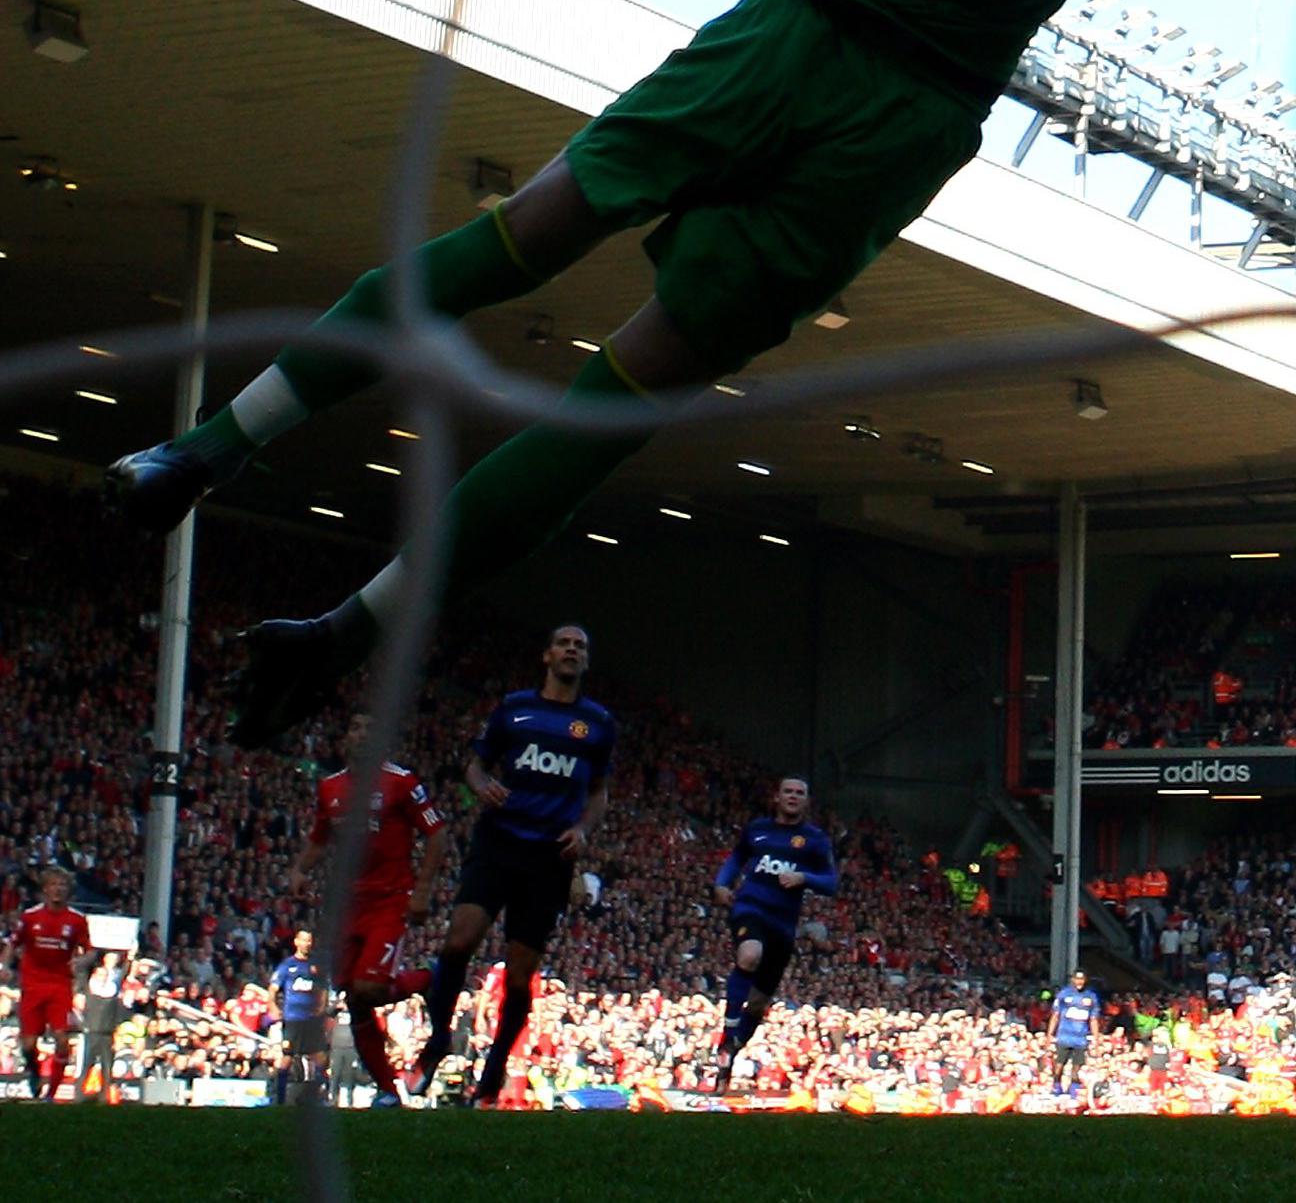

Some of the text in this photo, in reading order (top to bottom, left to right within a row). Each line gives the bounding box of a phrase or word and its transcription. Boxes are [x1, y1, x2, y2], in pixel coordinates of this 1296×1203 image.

[514, 743, 578, 779] AON
[1164, 760, 1251, 783] adidas
[379, 942, 395, 966] 7
